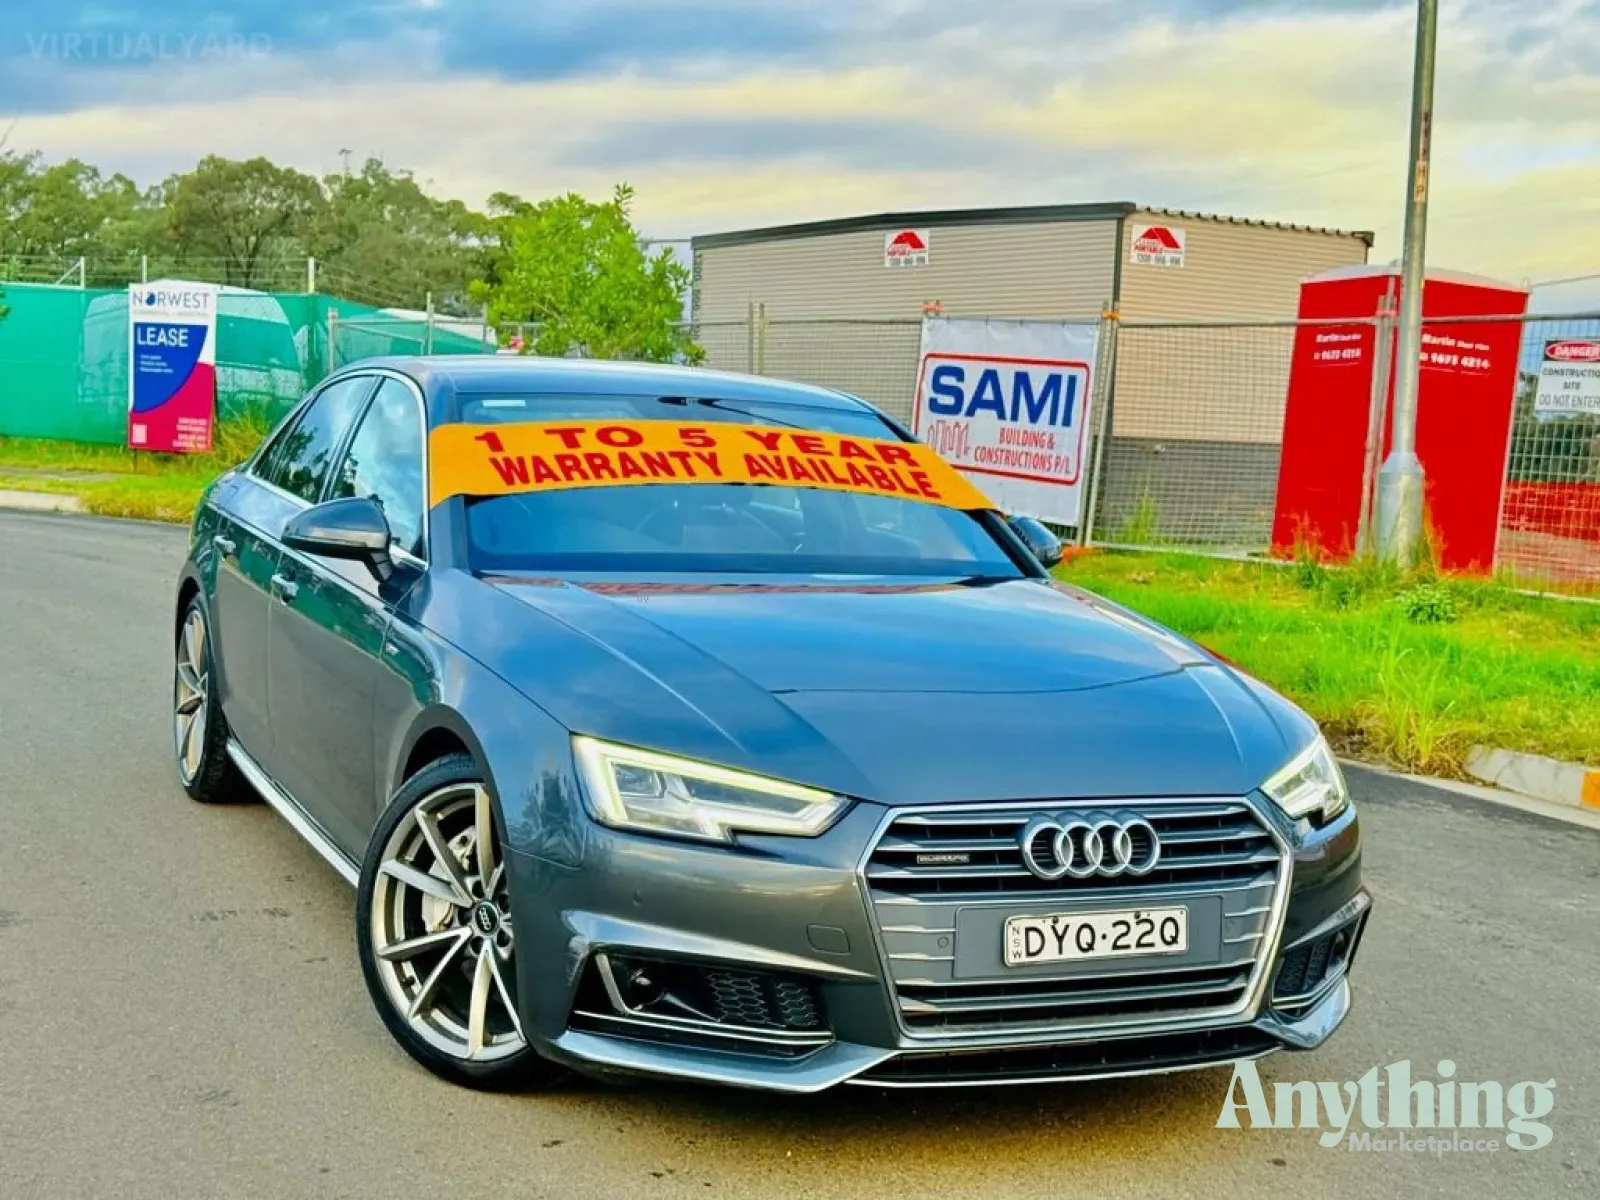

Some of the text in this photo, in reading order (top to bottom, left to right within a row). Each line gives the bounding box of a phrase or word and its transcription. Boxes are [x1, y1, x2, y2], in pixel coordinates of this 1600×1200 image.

[136, 326, 189, 348] LEASE
[928, 365, 1077, 428] SAMI
[475, 426, 920, 467] 1 TO 5 YEAR
[1000, 427, 1055, 450] BUILDING &
[489, 451, 942, 499] WARRANTY AVAILABLE
[975, 446, 1070, 474] CONSTRUCTIONS P/L
